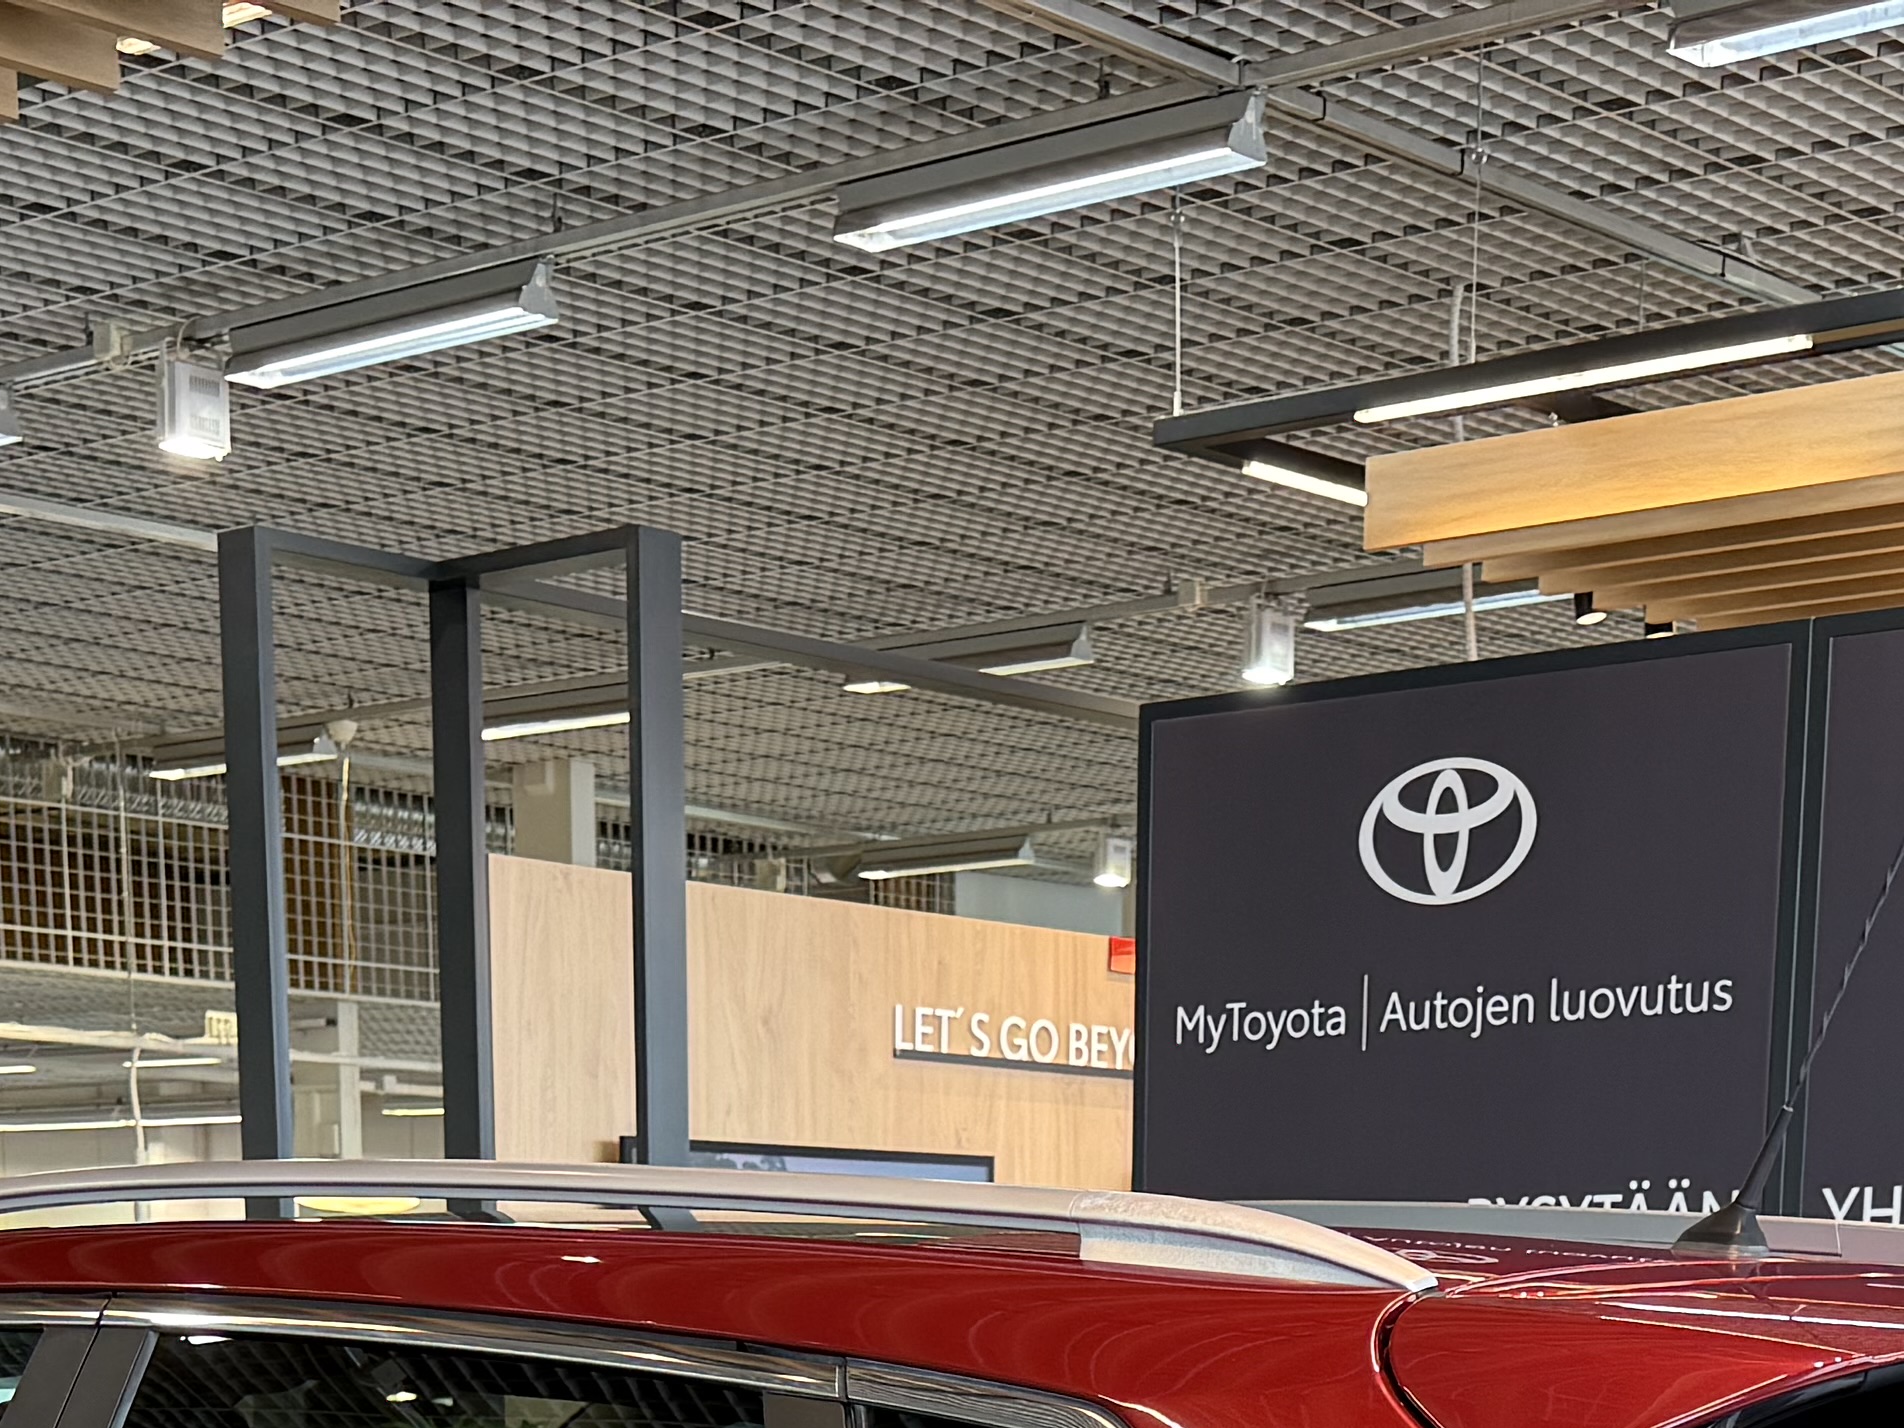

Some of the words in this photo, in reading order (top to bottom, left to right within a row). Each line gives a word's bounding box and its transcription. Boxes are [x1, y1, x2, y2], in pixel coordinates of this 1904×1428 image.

[999, 1016, 1059, 1063] GO
[1068, 1022, 1135, 1070] BEY
[1175, 999, 1347, 1054] MyToyota
[1379, 990, 1535, 1040] Autojen
[1549, 974, 1734, 1022] luovutus
